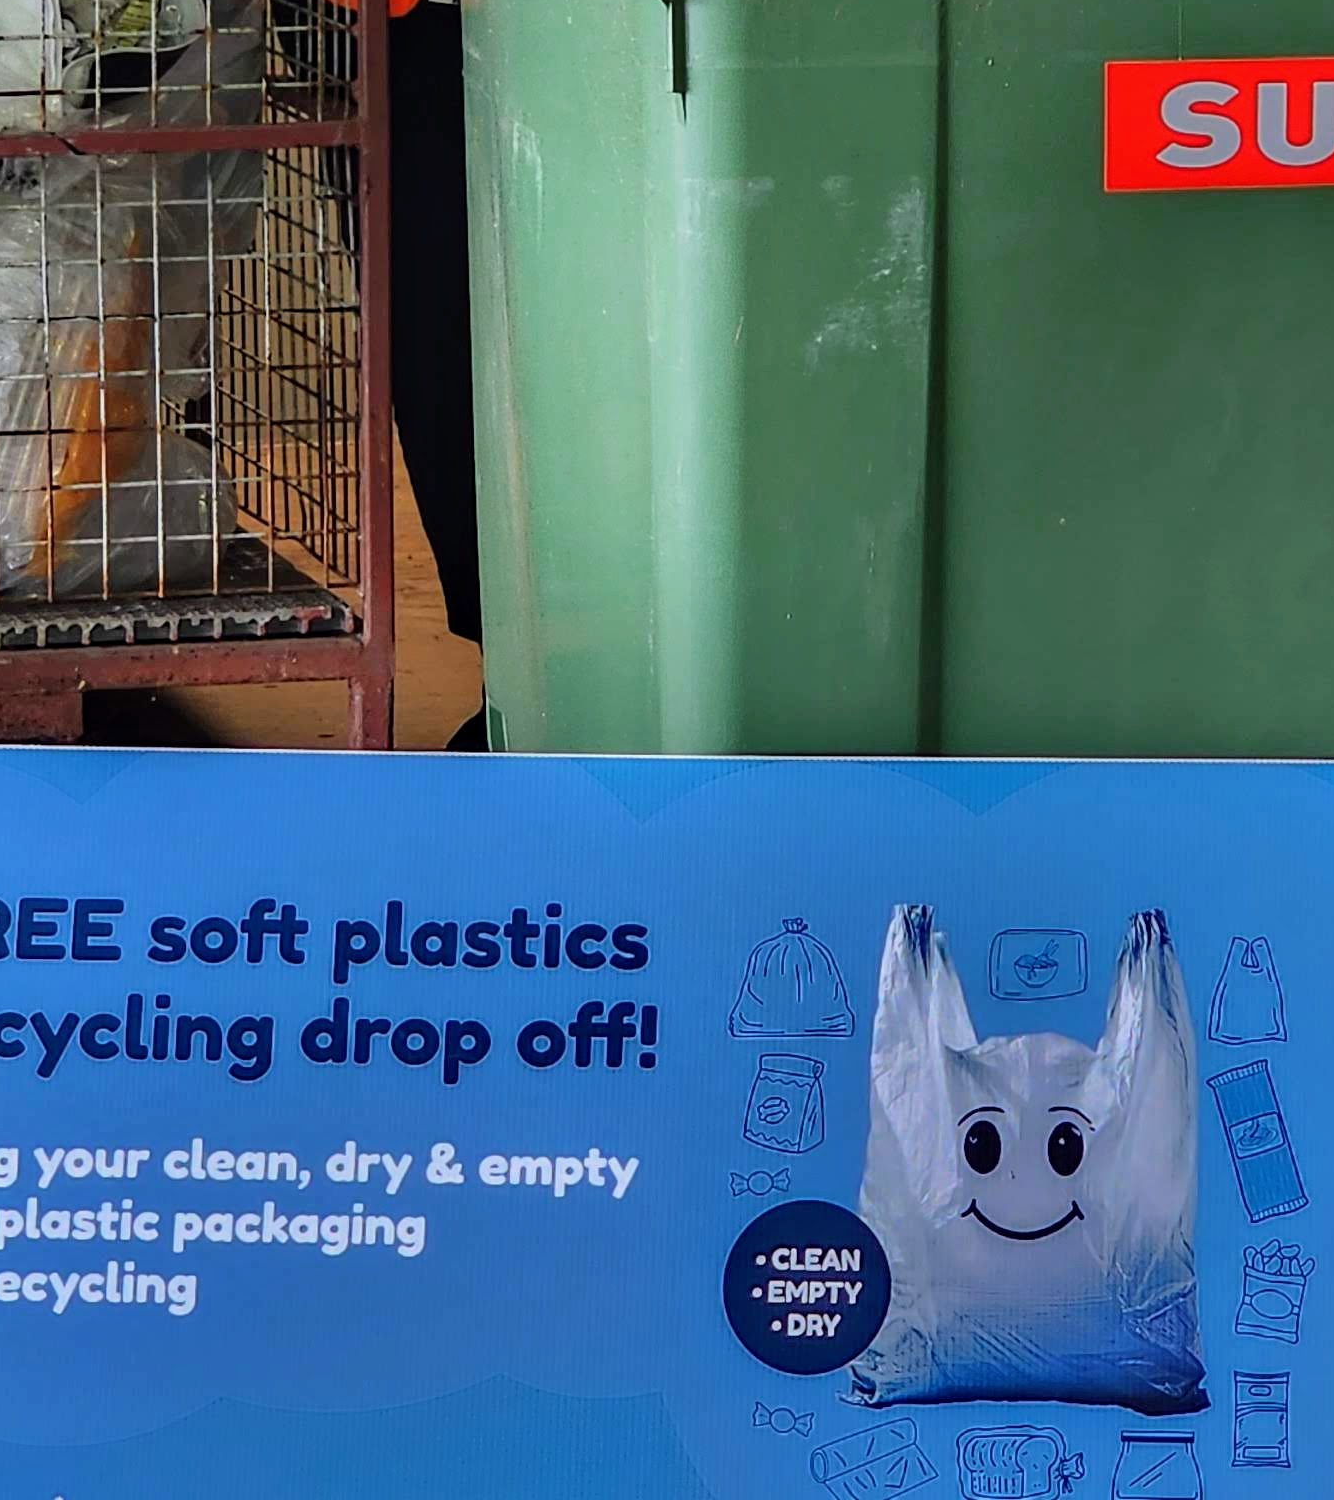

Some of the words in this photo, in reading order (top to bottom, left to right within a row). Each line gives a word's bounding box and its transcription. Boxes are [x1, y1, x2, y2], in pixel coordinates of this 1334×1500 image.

[146, 898, 308, 965] soft
[332, 899, 651, 985] plastics
[299, 996, 492, 1086] drop
[515, 1000, 659, 1069] off!
[34, 1142, 150, 1188] your
[163, 1138, 311, 1189] clean,
[325, 1141, 413, 1194] dry
[426, 1144, 464, 1185] &
[478, 1151, 639, 1199] empty
[173, 1202, 425, 1256] packaging
[771, 1248, 861, 1272] CLEAN
[767, 1281, 863, 1304] EMPTY
[787, 1313, 841, 1338] DRY
